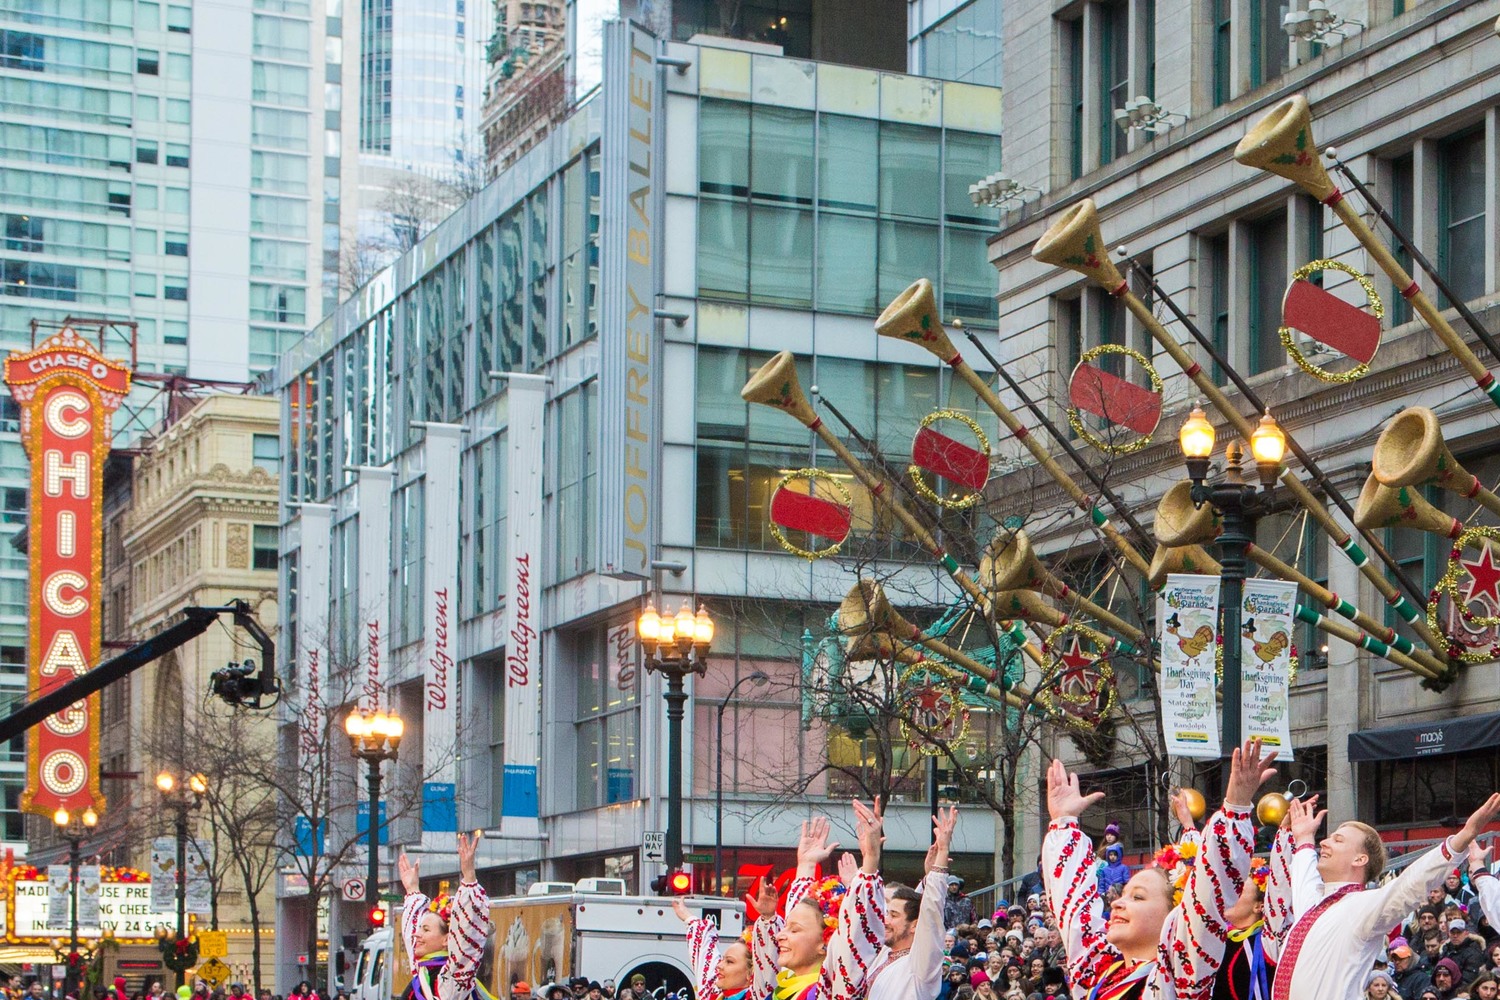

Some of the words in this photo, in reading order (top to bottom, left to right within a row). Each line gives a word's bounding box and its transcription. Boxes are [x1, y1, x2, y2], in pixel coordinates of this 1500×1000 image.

[627, 31, 652, 266] BALLET
[29, 354, 90, 374] CHASE
[624, 283, 650, 570] JOFFREY
[40, 391, 91, 797] CHICAGO
[1180, 600, 1208, 608] Parade
[1257, 605, 1284, 614] Parade
[509, 552, 537, 688] Walgreens
[427, 587, 454, 712] Walgreens
[361, 619, 383, 716] algreens
[1166, 667, 1210, 681] Thanksgiving
[1180, 679, 1196, 691] Day
[1241, 671, 1284, 686] Thanksgiving
[1254, 683, 1269, 694] Day
[1421, 728, 1443, 743] macy's
[645, 834, 663, 842] ONE
[125, 921, 140, 931] 24
